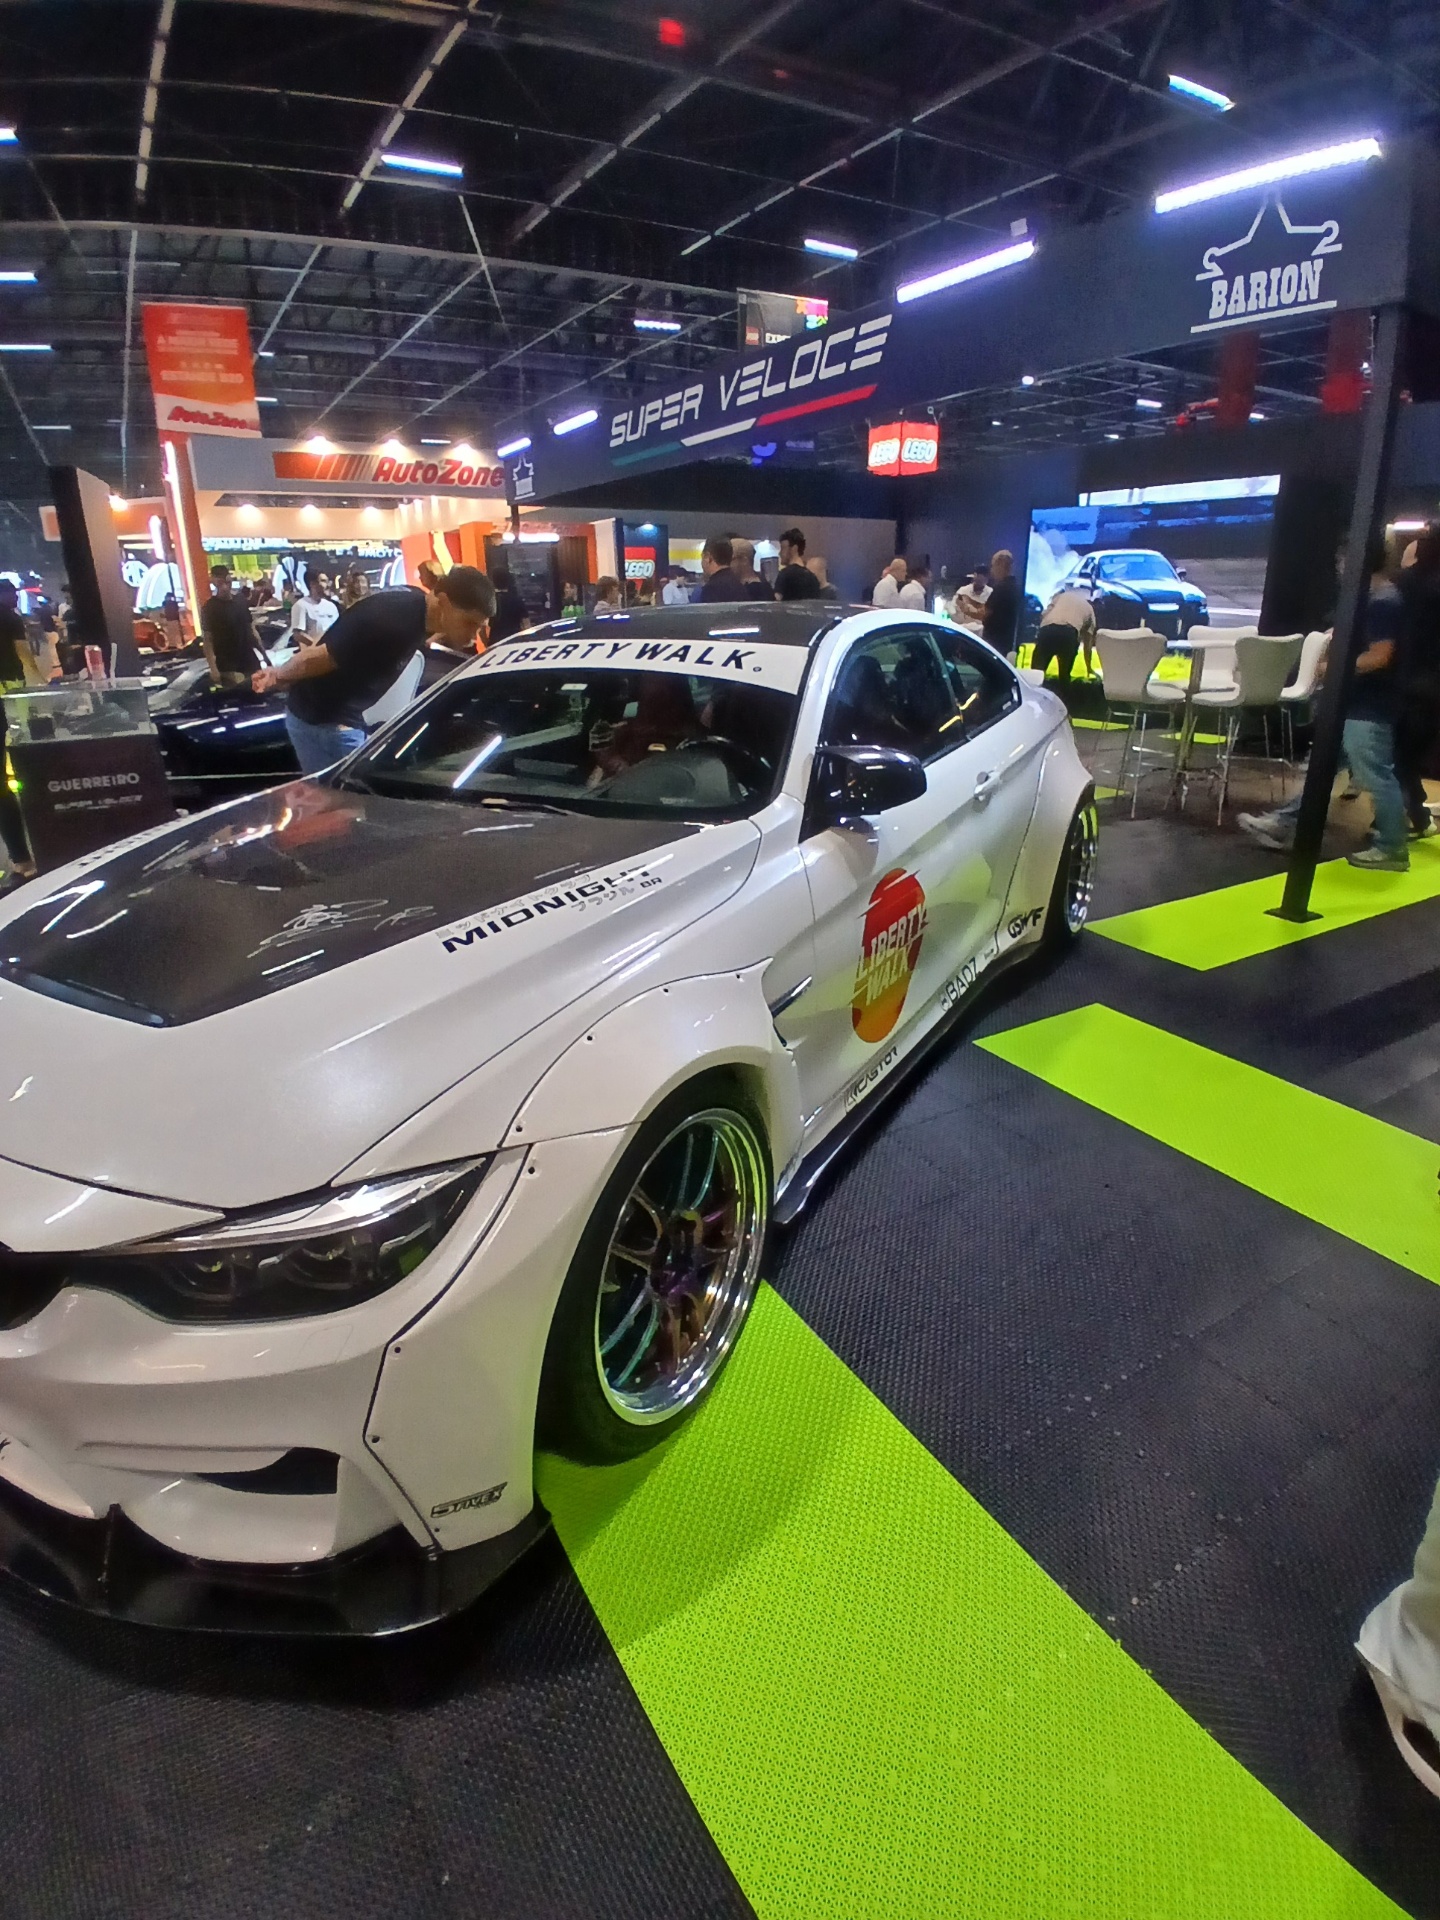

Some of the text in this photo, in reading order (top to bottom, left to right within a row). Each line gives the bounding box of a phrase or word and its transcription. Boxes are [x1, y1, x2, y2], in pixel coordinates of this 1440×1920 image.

[1209, 258, 1323, 320] BARION
[609, 314, 893, 447] SUPER VELOCE
[372, 457, 505, 487] AutoZone
[902, 438, 937, 464] LEGO
[480, 642, 756, 671] LIBERTY WALK
[48, 773, 140, 792] GUERREIRO
[442, 864, 650, 953] MIDNIGHT
[857, 901, 928, 982] LIBERTY
